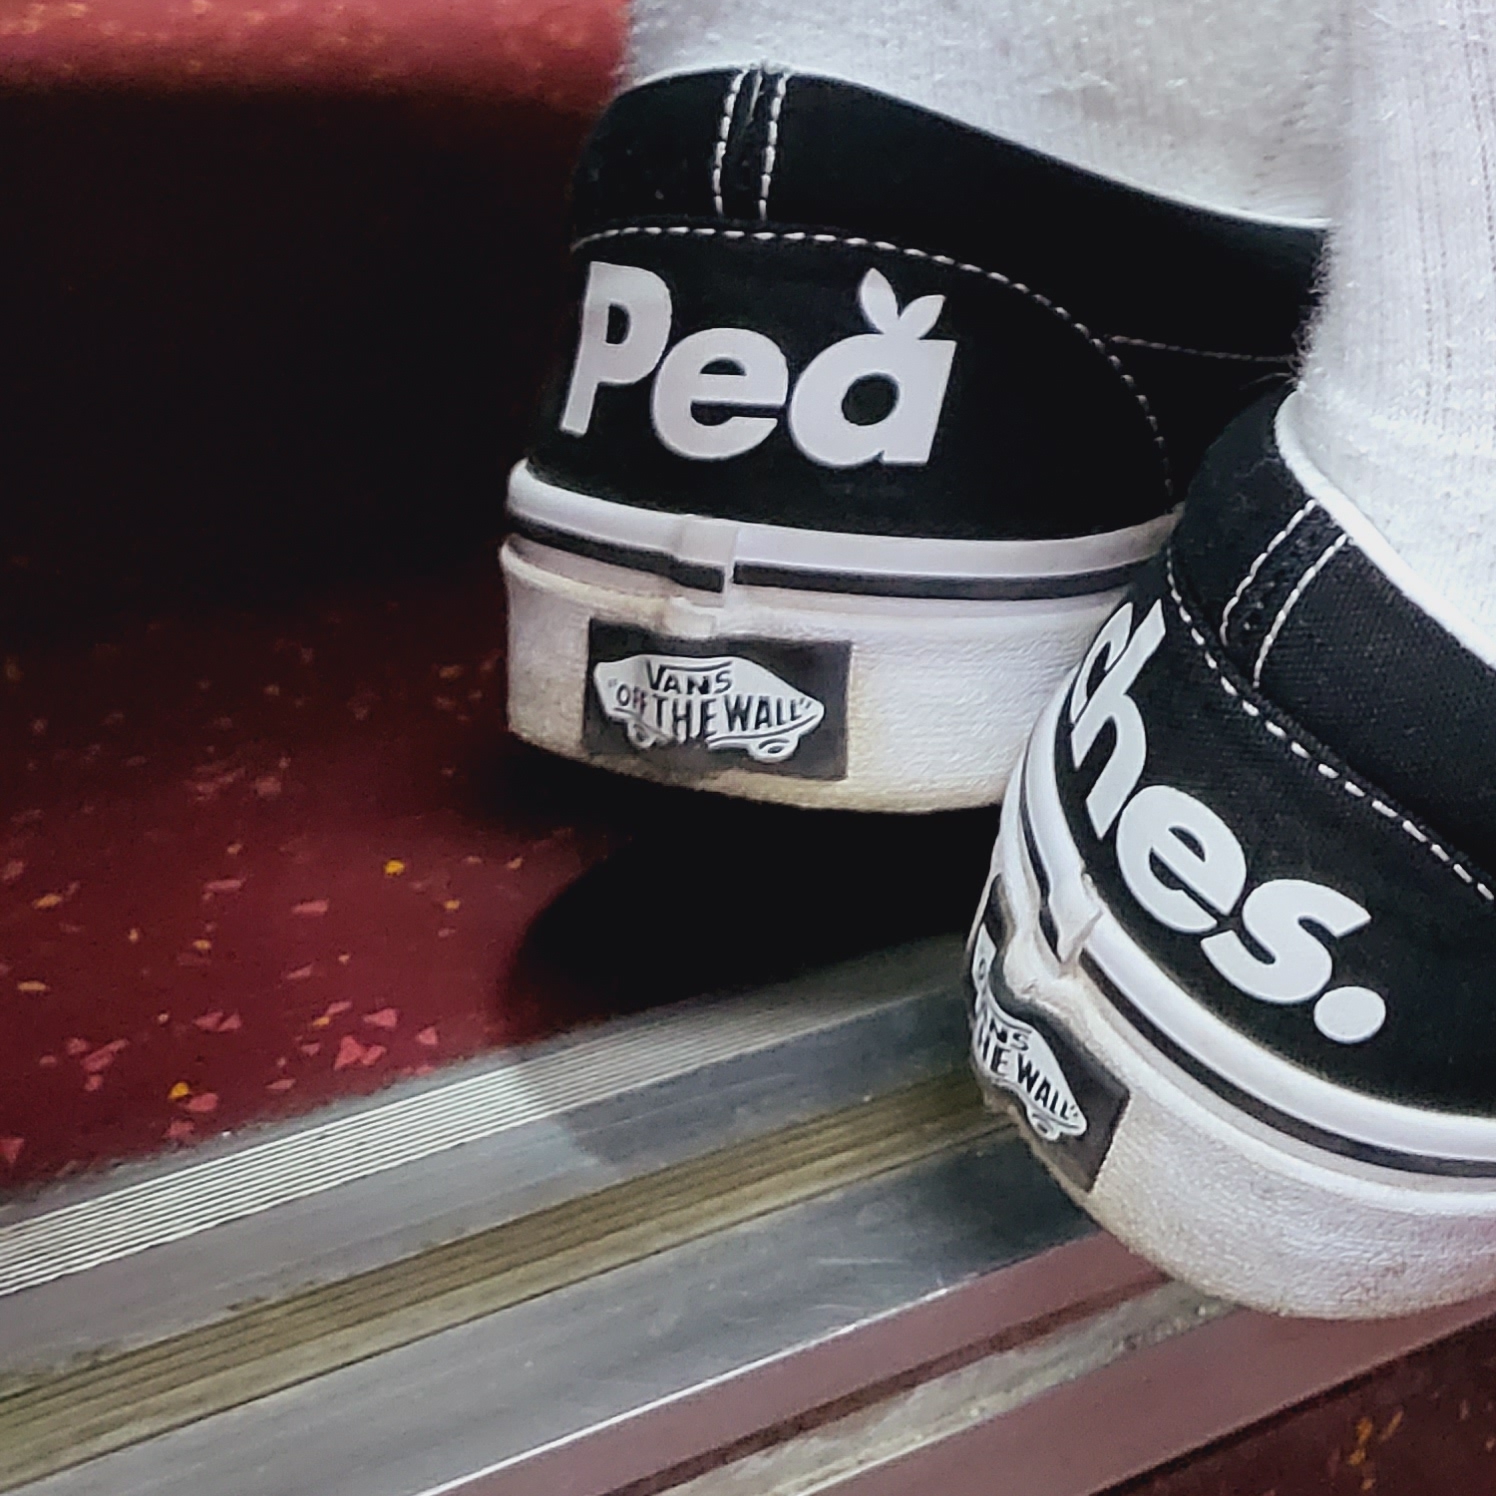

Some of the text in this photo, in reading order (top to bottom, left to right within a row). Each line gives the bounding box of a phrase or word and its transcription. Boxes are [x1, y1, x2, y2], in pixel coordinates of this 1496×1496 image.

[559, 261, 957, 468] Pea
[645, 658, 735, 696] VANS
[652, 693, 718, 745] THE
